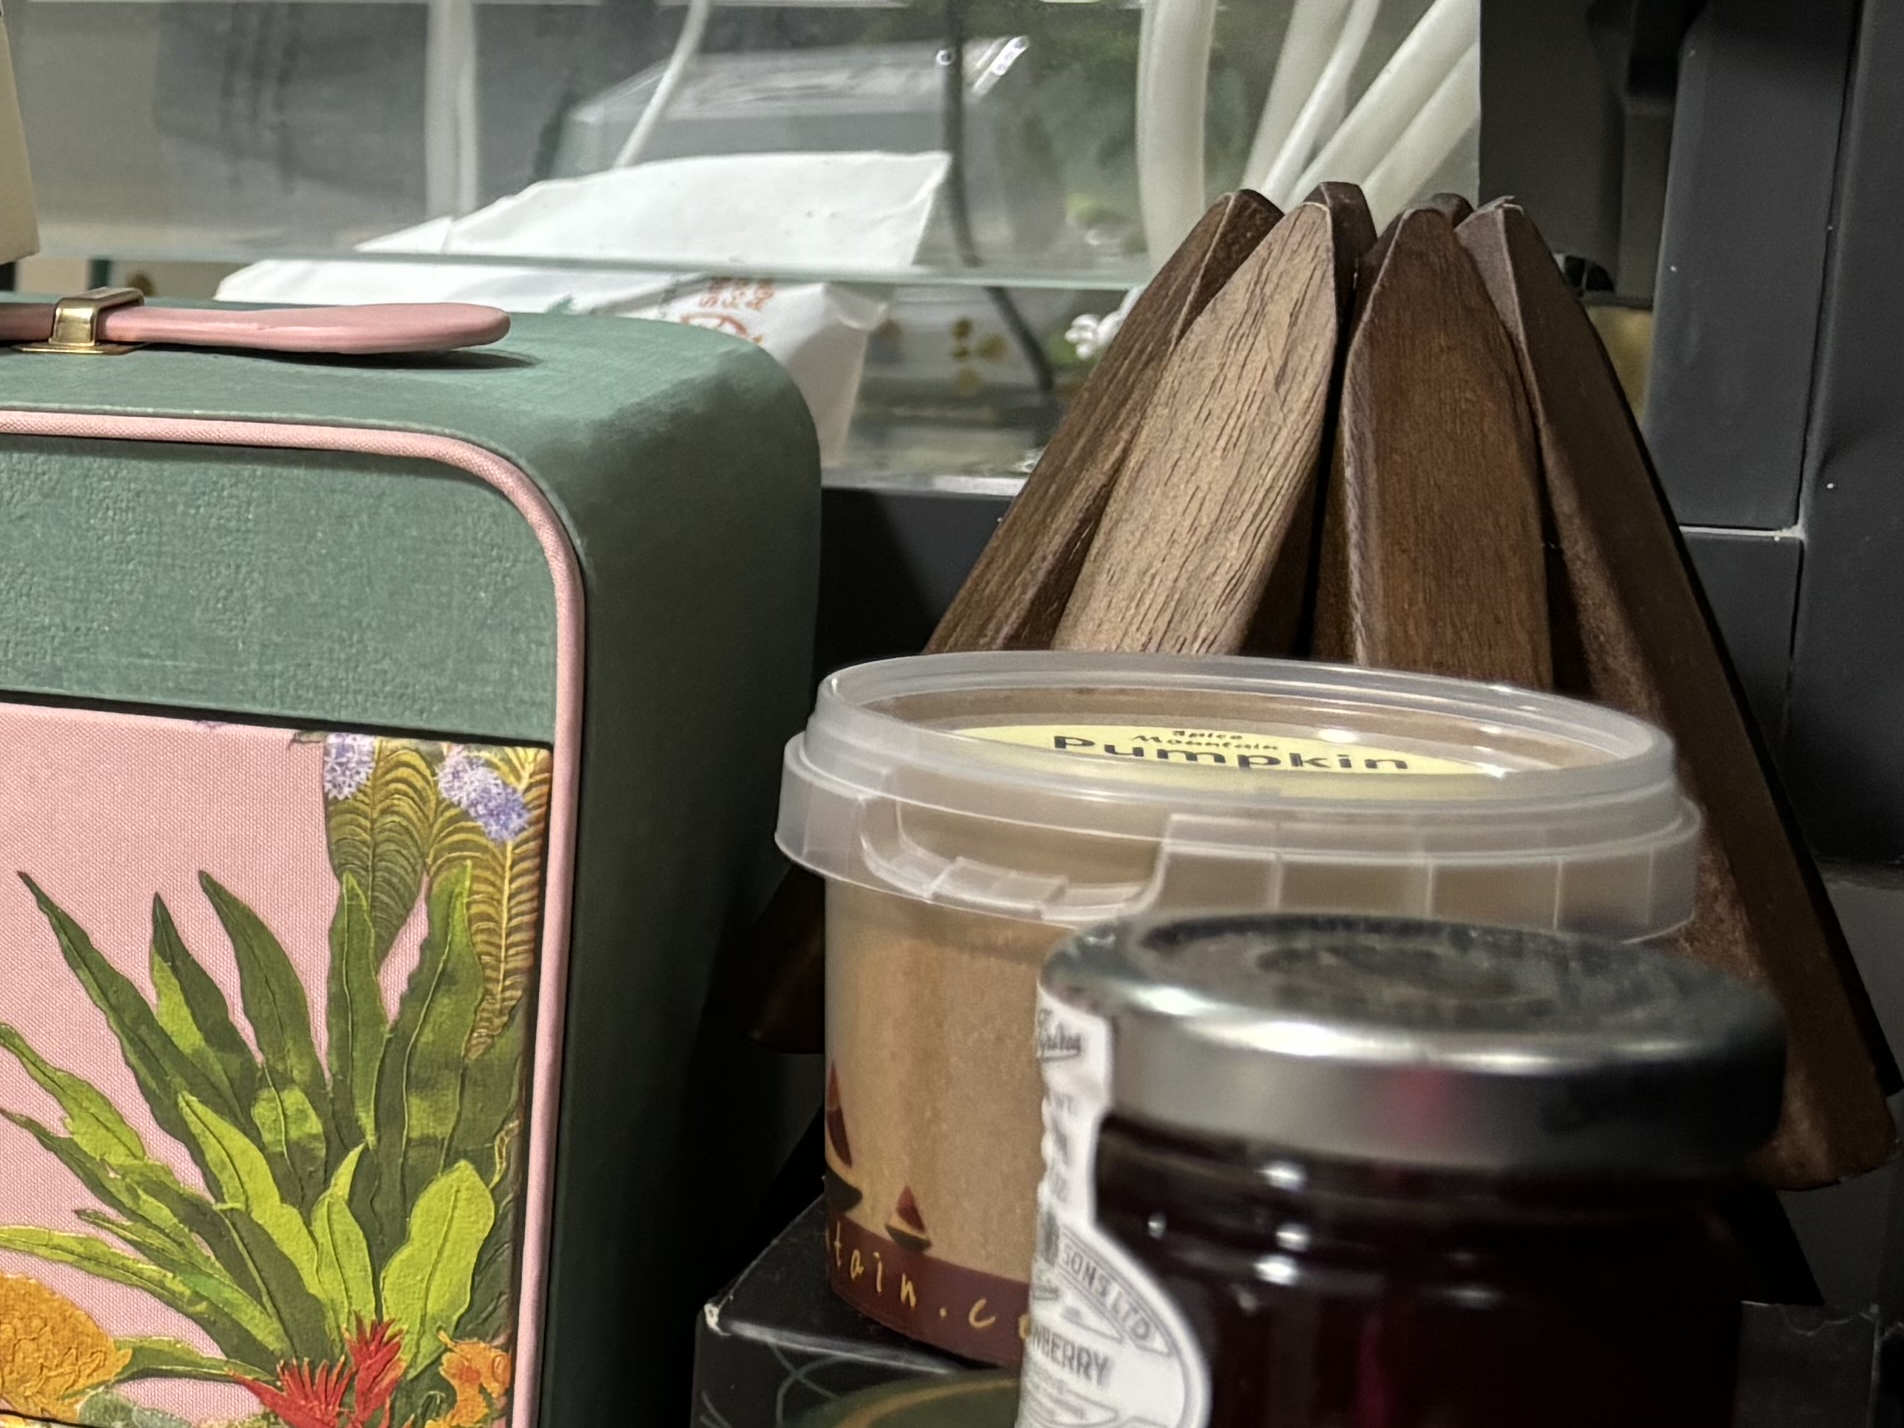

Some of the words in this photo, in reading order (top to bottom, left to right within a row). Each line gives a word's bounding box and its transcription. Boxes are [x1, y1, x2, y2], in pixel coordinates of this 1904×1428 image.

[1053, 735, 1409, 771] Pumpkin
[1061, 1241, 1113, 1298] SONS
[1110, 1292, 1152, 1340] LTD
